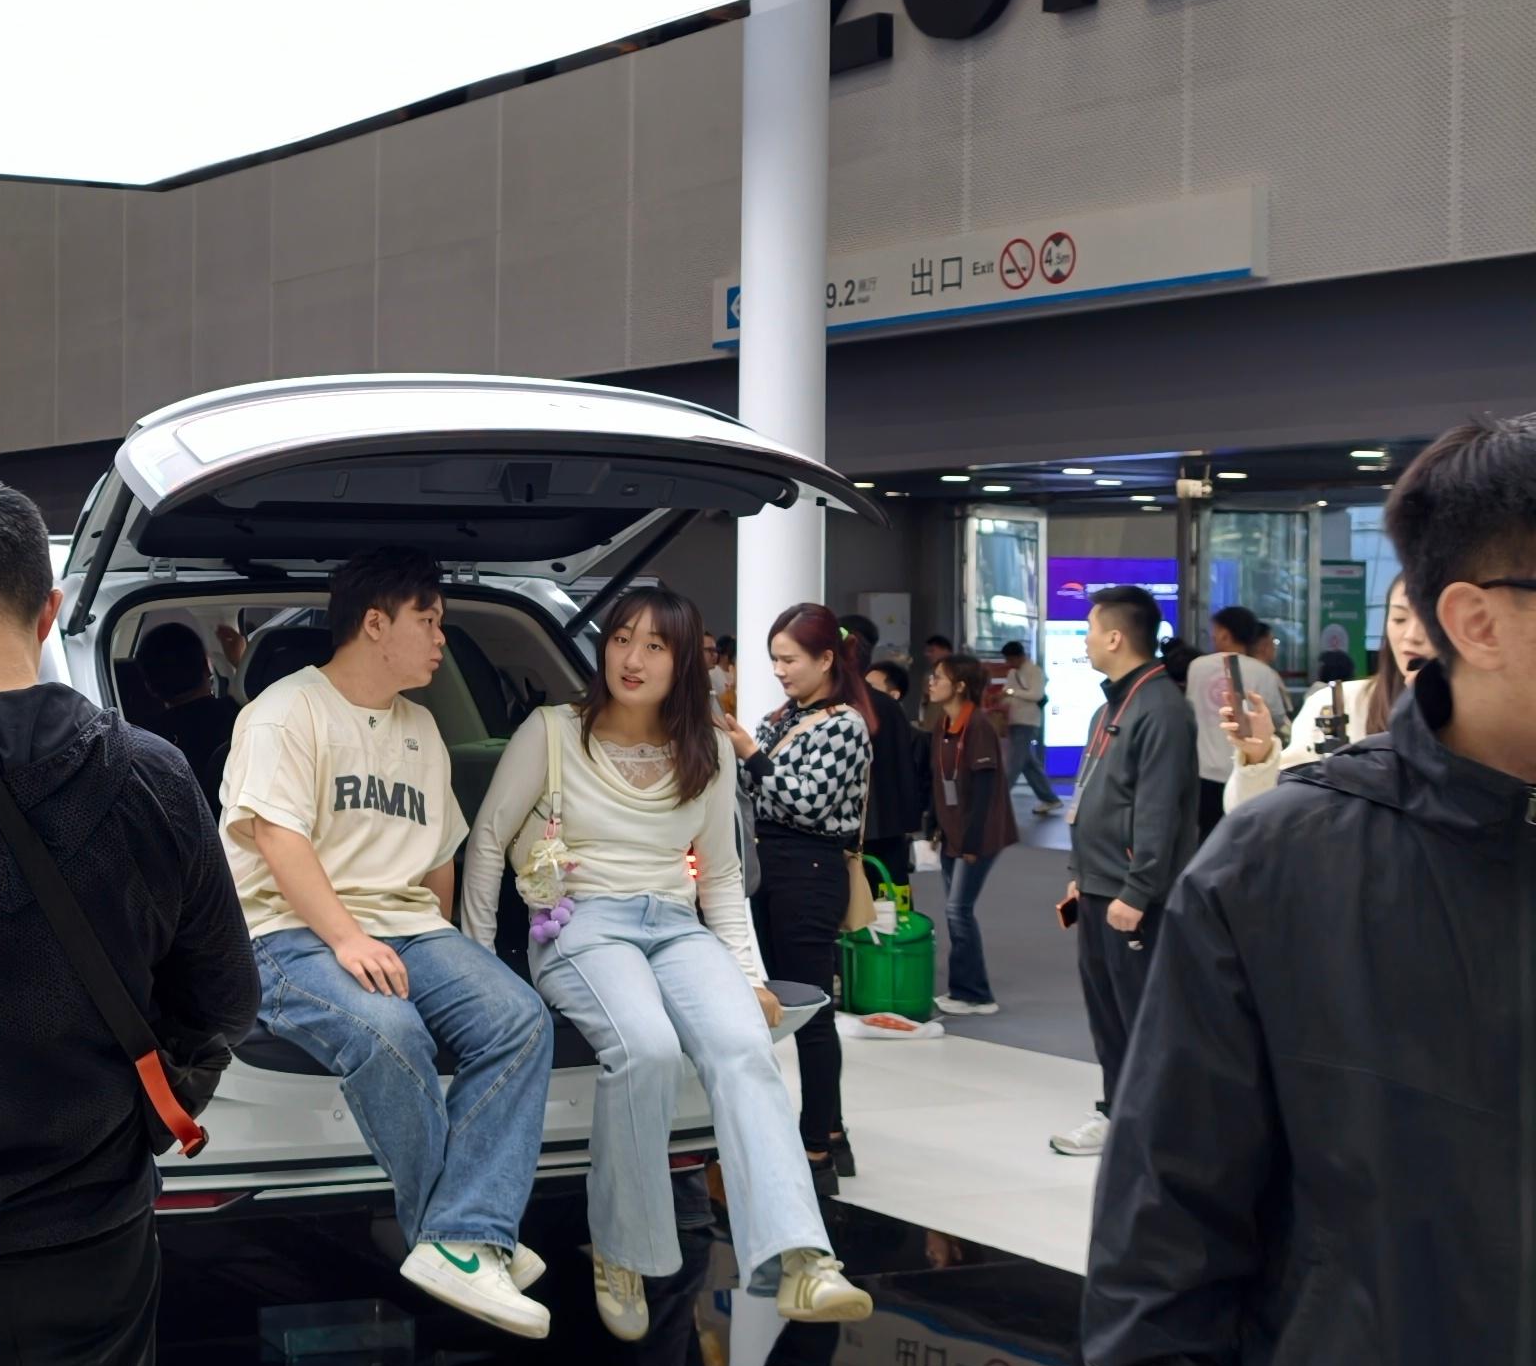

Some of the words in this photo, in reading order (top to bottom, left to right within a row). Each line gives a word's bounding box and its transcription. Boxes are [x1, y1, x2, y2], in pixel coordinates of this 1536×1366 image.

[911, 257, 963, 297] 出口
[973, 261, 994, 276] Exit
[334, 774, 427, 826] RAMN
